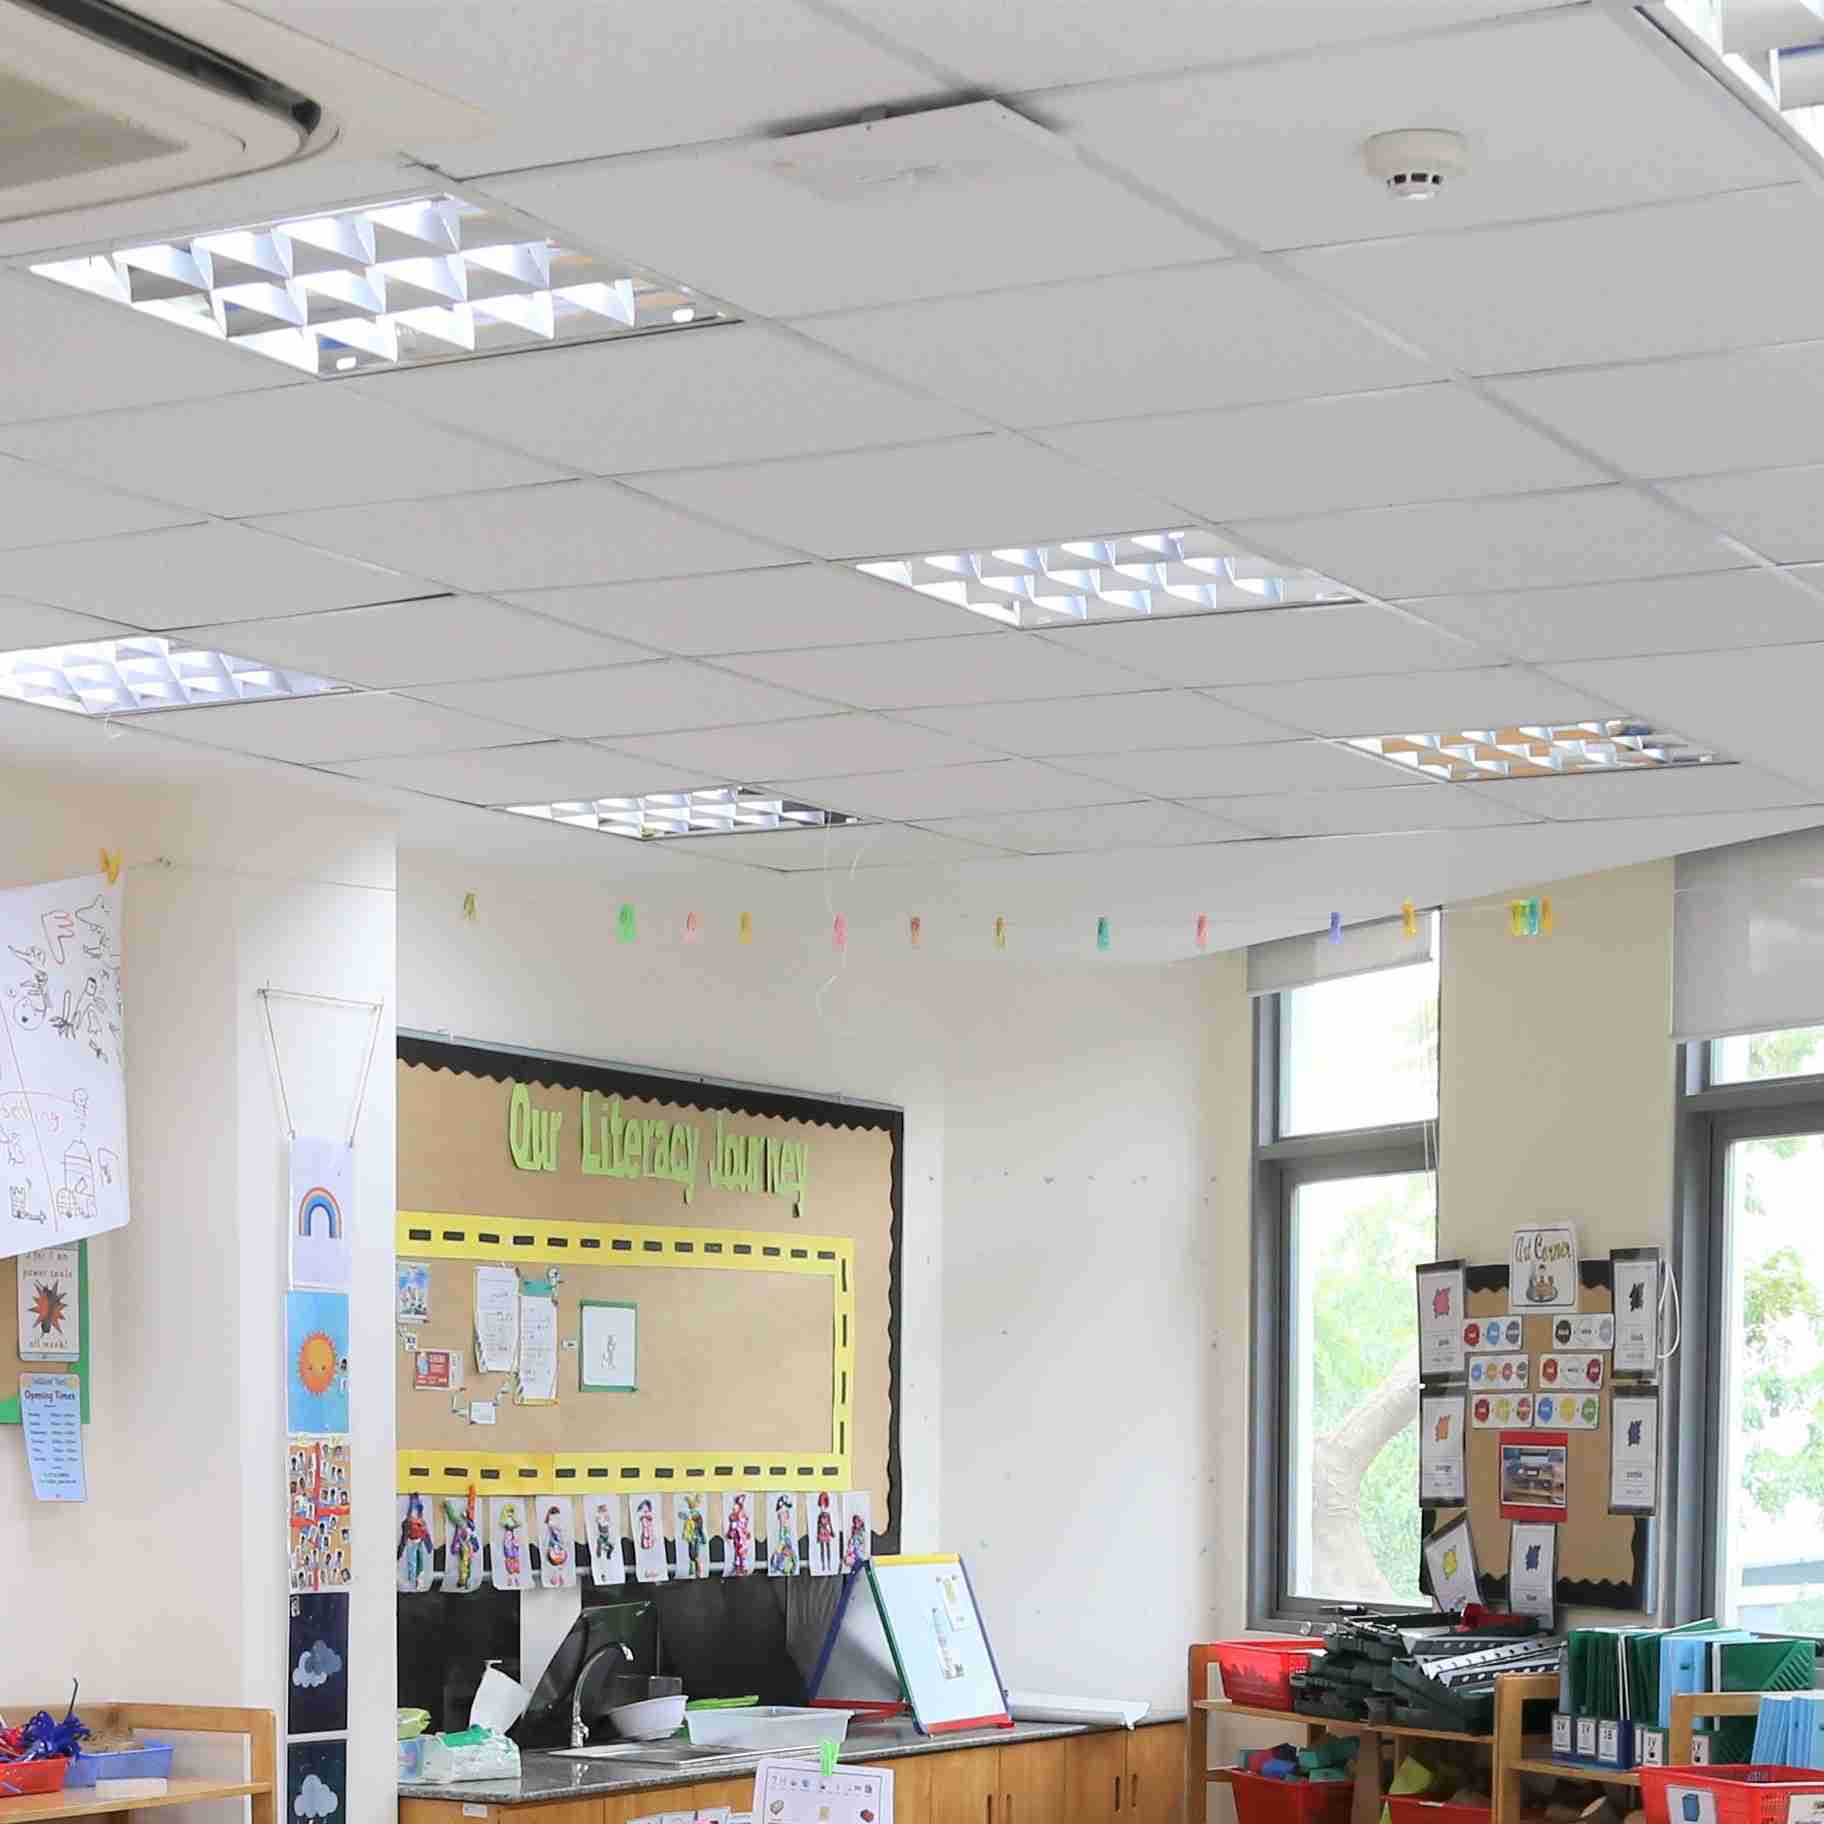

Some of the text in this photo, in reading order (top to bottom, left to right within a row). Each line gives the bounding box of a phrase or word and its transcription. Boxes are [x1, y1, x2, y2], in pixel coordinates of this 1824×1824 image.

[508, 1083, 809, 1218] Our Literacy Journey
[24, 1389, 76, 1402] Opening Times
